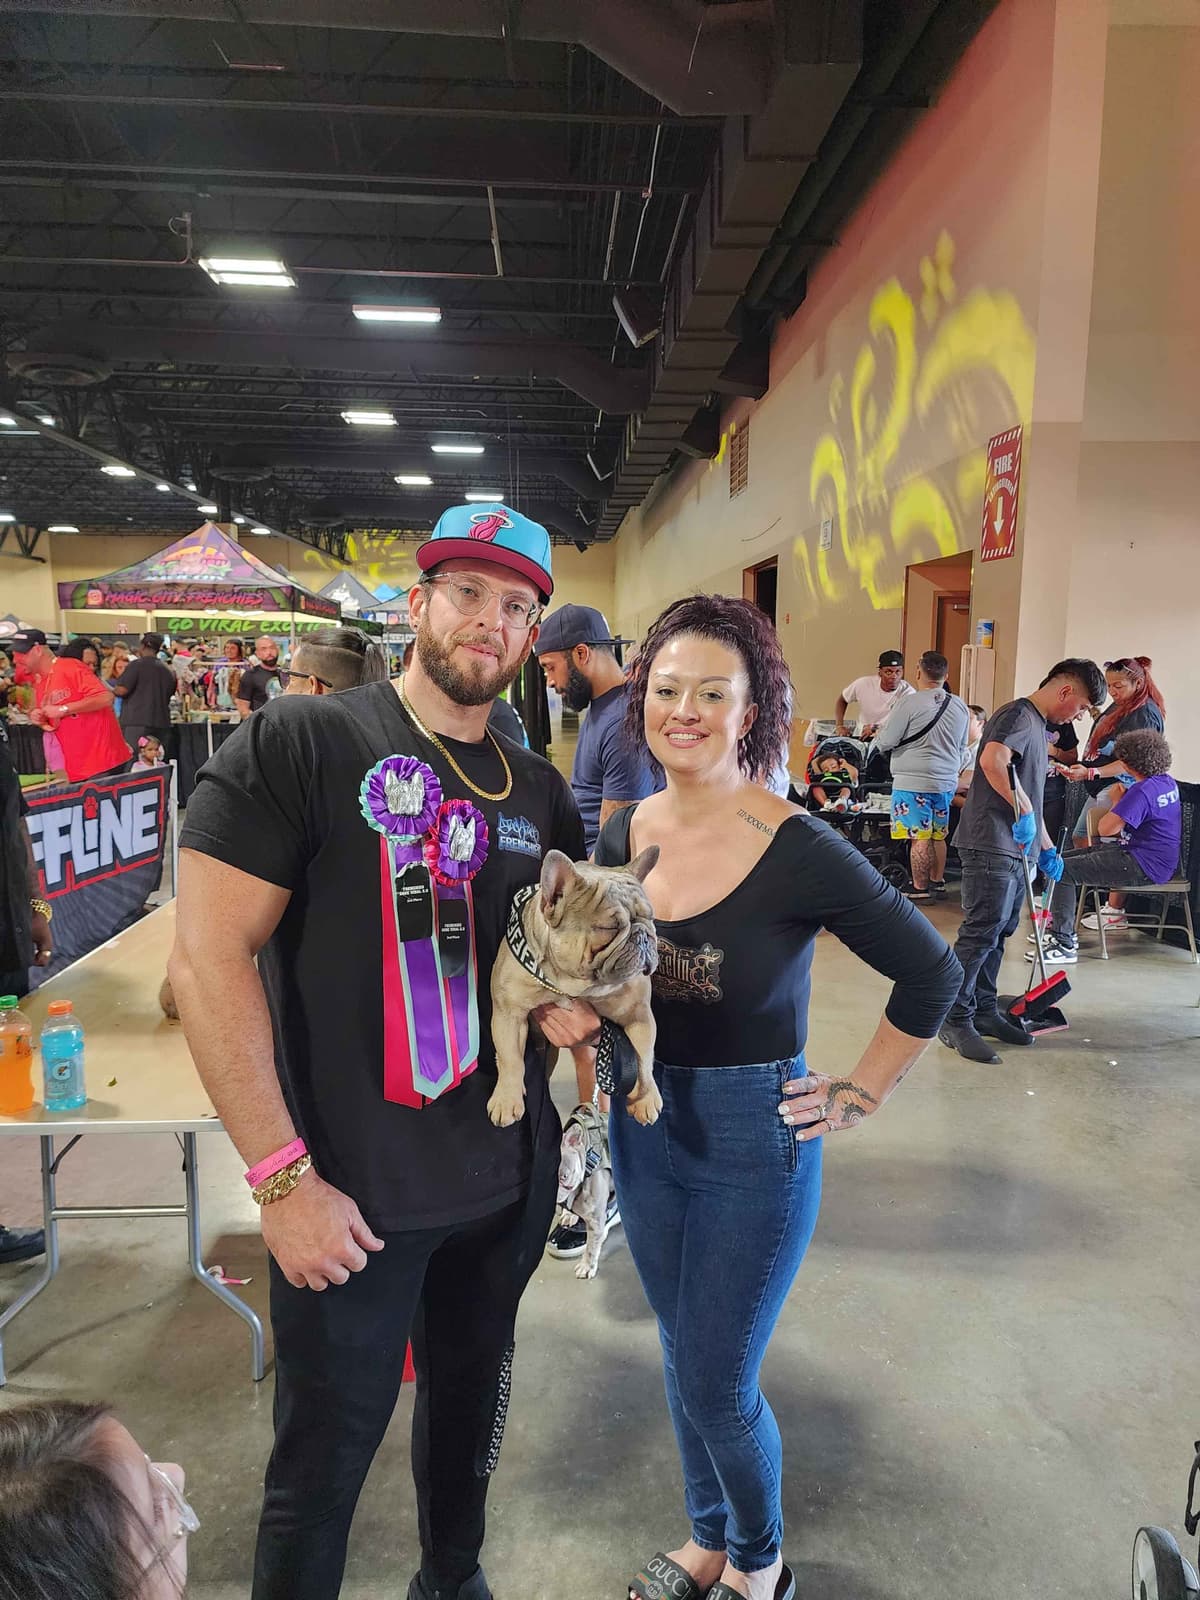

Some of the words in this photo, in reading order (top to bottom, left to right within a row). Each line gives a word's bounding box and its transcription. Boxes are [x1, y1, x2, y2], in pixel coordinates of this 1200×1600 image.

[994, 453, 1012, 477] FIRE
[167, 618, 193, 634] GO
[198, 619, 255, 633] VIRAL
[260, 620, 334, 634] EXOTIC
[647, 1558, 692, 1600] GUCCI
